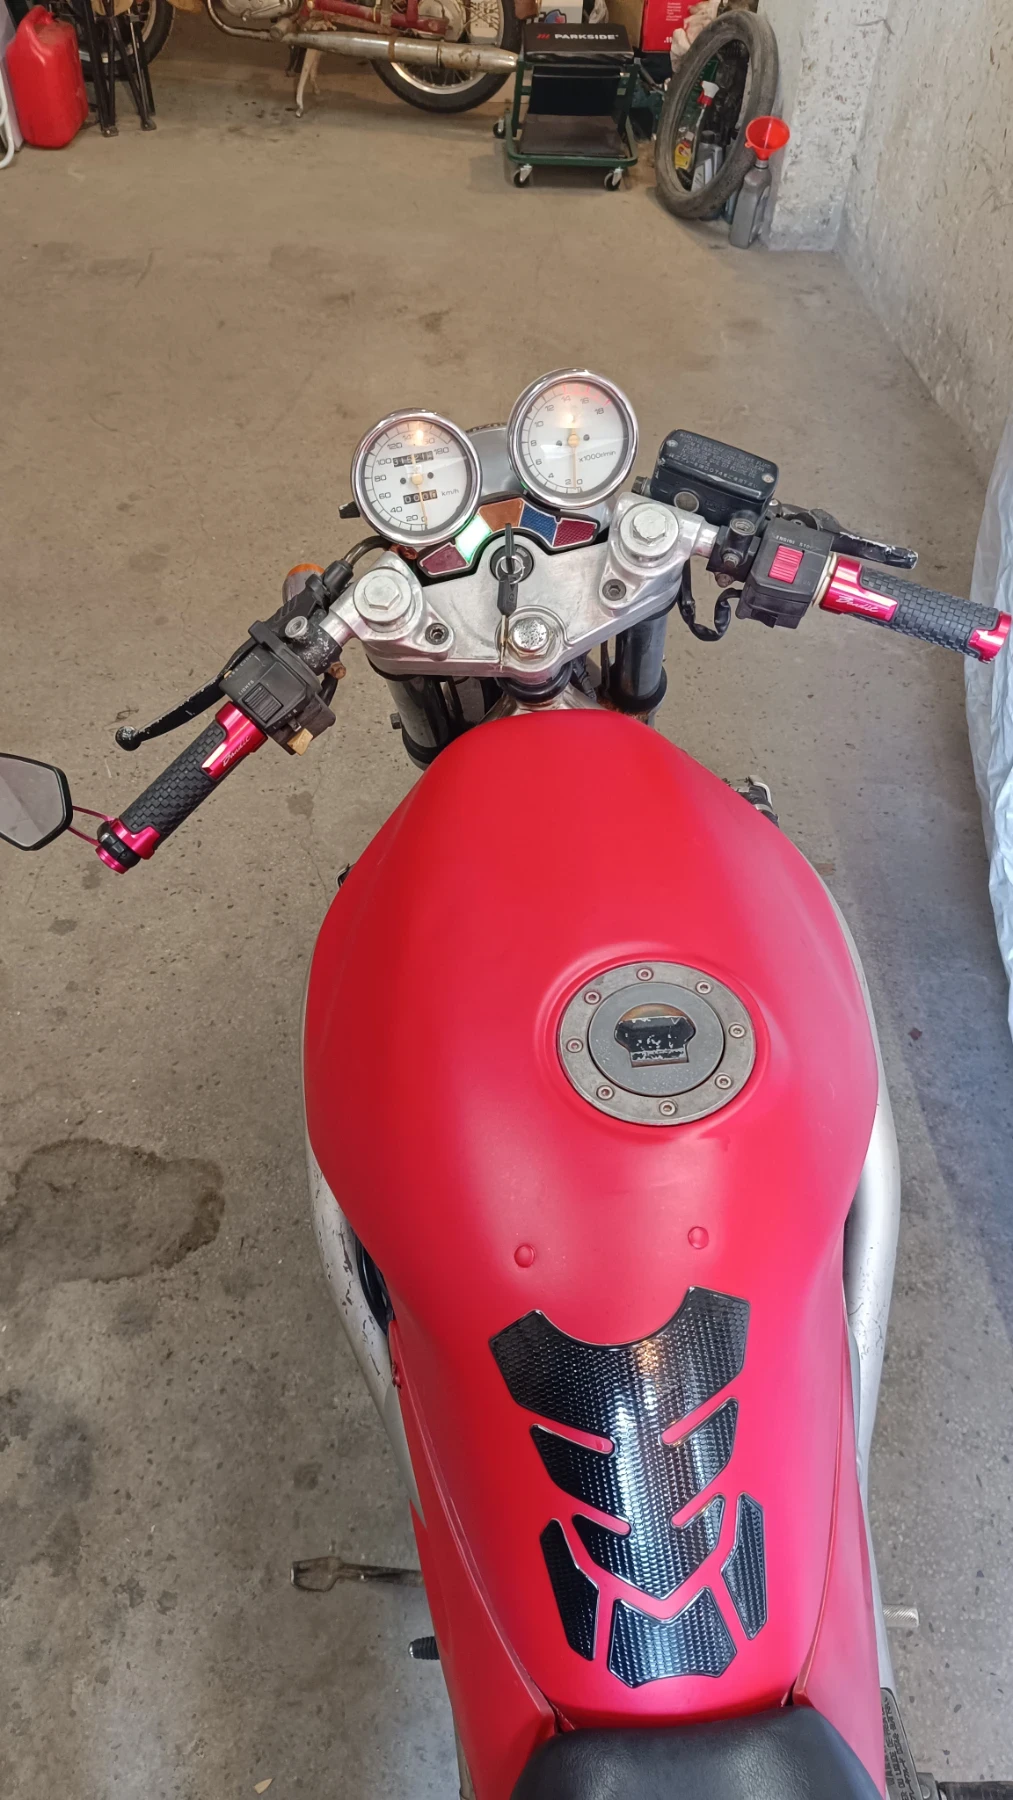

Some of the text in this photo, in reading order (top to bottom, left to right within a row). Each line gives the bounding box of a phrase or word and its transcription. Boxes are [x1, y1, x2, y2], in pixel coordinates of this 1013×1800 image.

[545, 404, 555, 412] 12
[387, 442, 403, 450] 120
[433, 446, 449, 455] 180
[376, 458, 392, 466] 100
[374, 474, 387, 483] 80
[378, 491, 392, 500] 60
[441, 488, 460, 497] km/h
[405, 514, 418, 522] 20
[238, 680, 255, 696] LIGHTS
